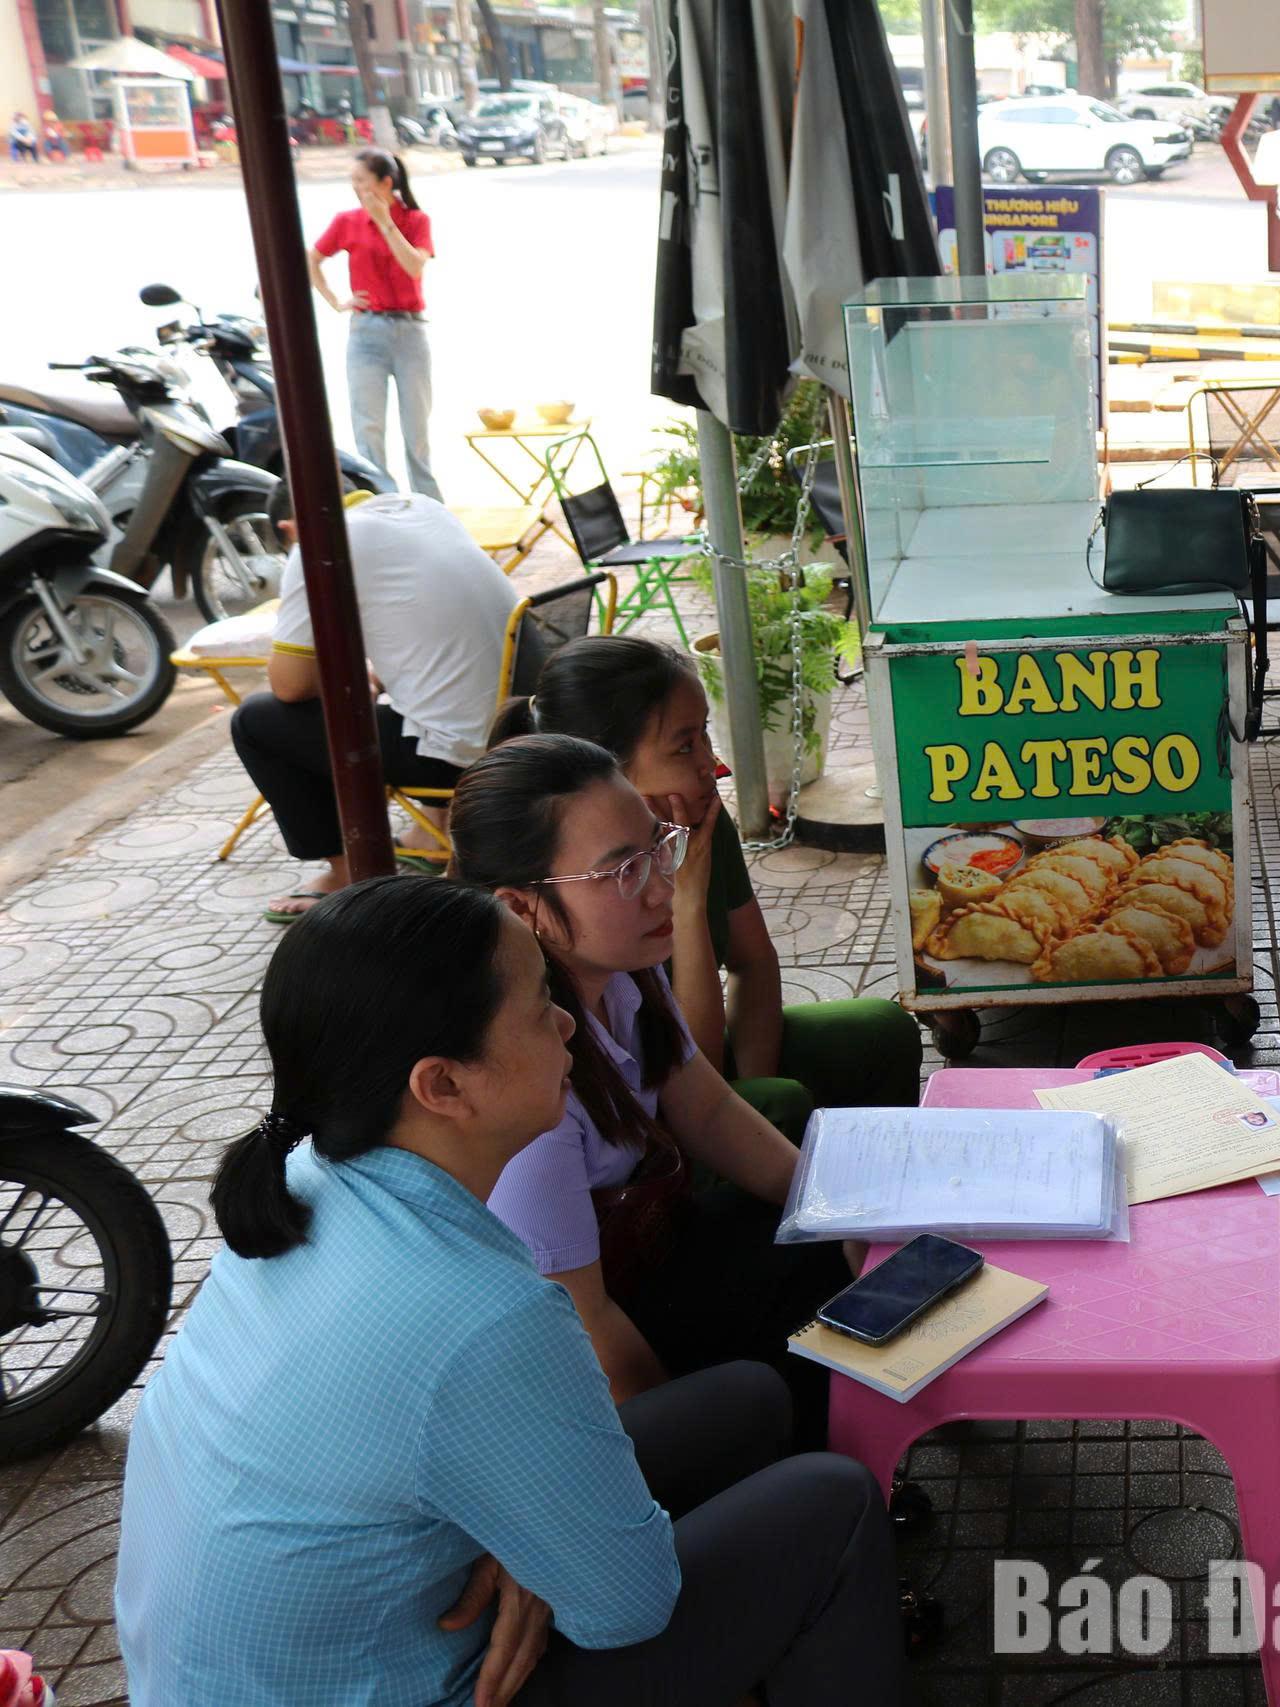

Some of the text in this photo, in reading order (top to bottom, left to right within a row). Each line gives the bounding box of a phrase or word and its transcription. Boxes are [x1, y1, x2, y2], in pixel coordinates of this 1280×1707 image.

[984, 213, 1058, 227] INGAPORE
[955, 648, 1162, 717] BANH
[923, 733, 1201, 803] PATESO
